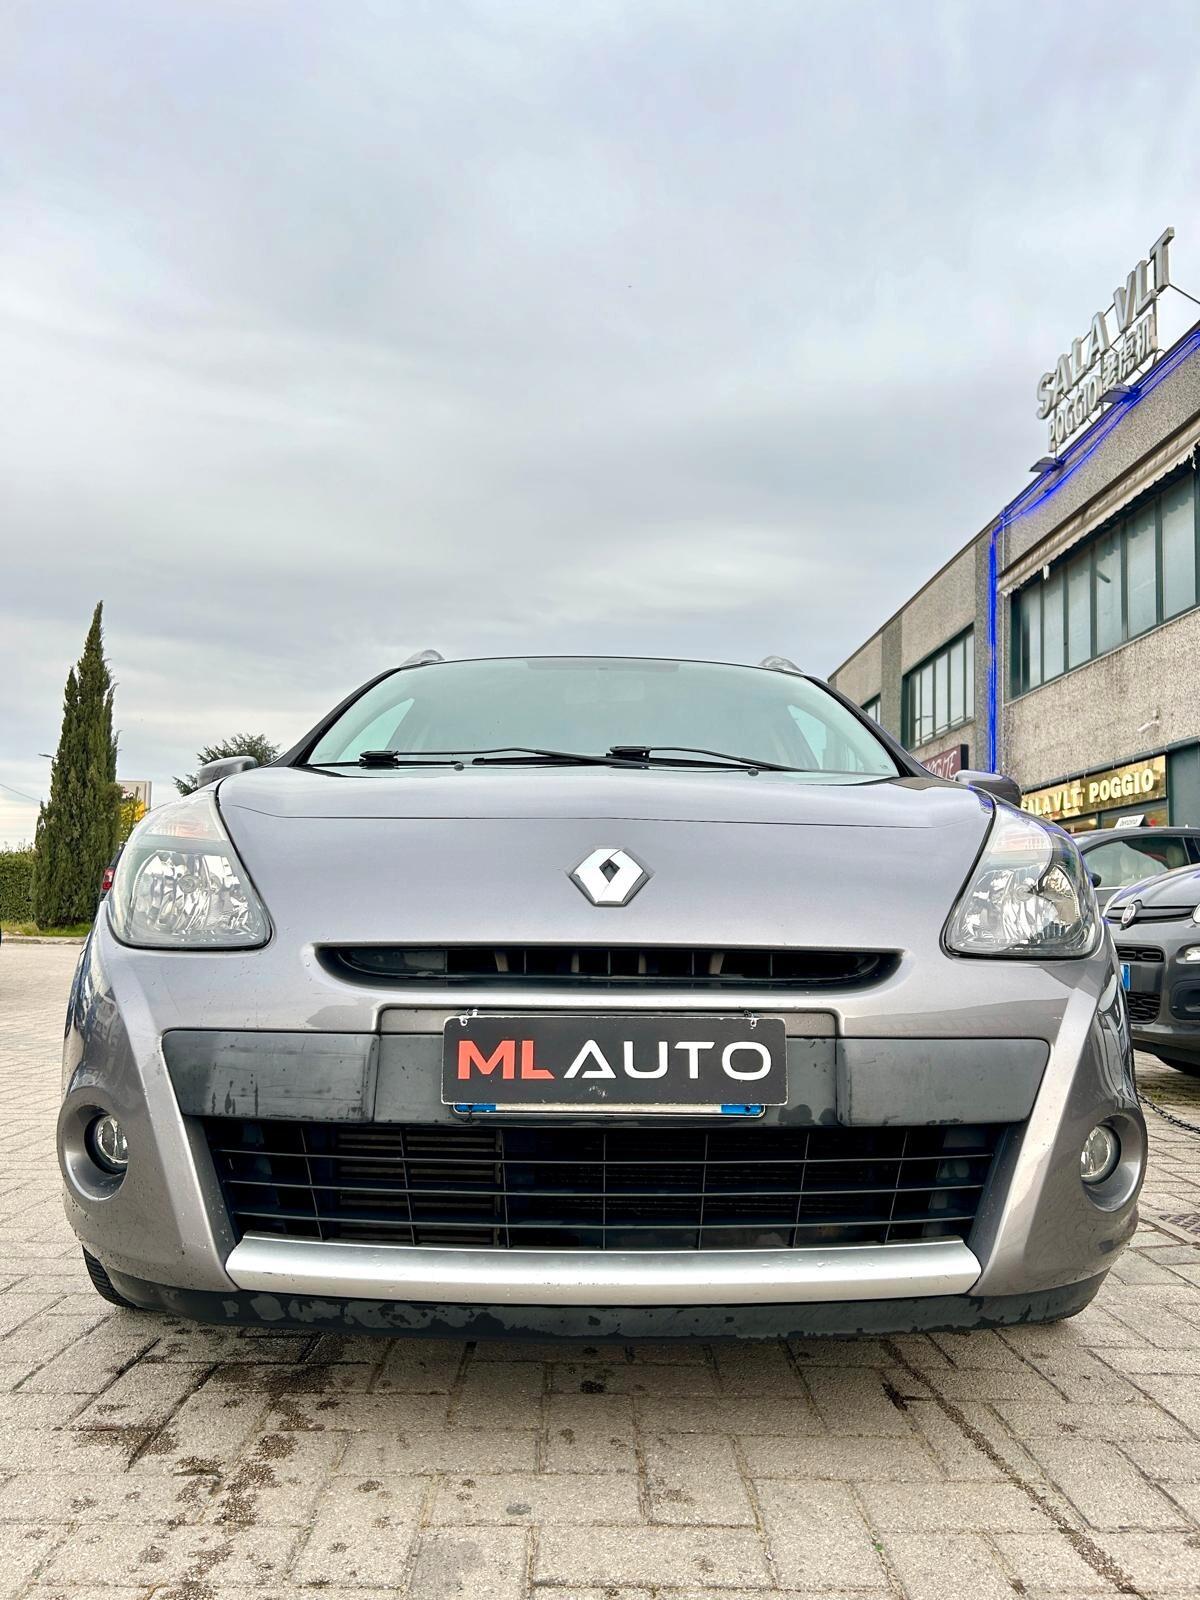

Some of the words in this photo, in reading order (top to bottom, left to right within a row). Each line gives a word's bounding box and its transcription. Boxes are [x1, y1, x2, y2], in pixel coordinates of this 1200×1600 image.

[1037, 312, 1110, 420] SALA
[1113, 227, 1174, 333] VLT
[1048, 375, 1103, 453] POGGIO
[1053, 788, 1081, 812] VLT
[1089, 769, 1154, 804] POGGIO
[457, 1040, 555, 1080] ML
[563, 1039, 773, 1081] AUTO
